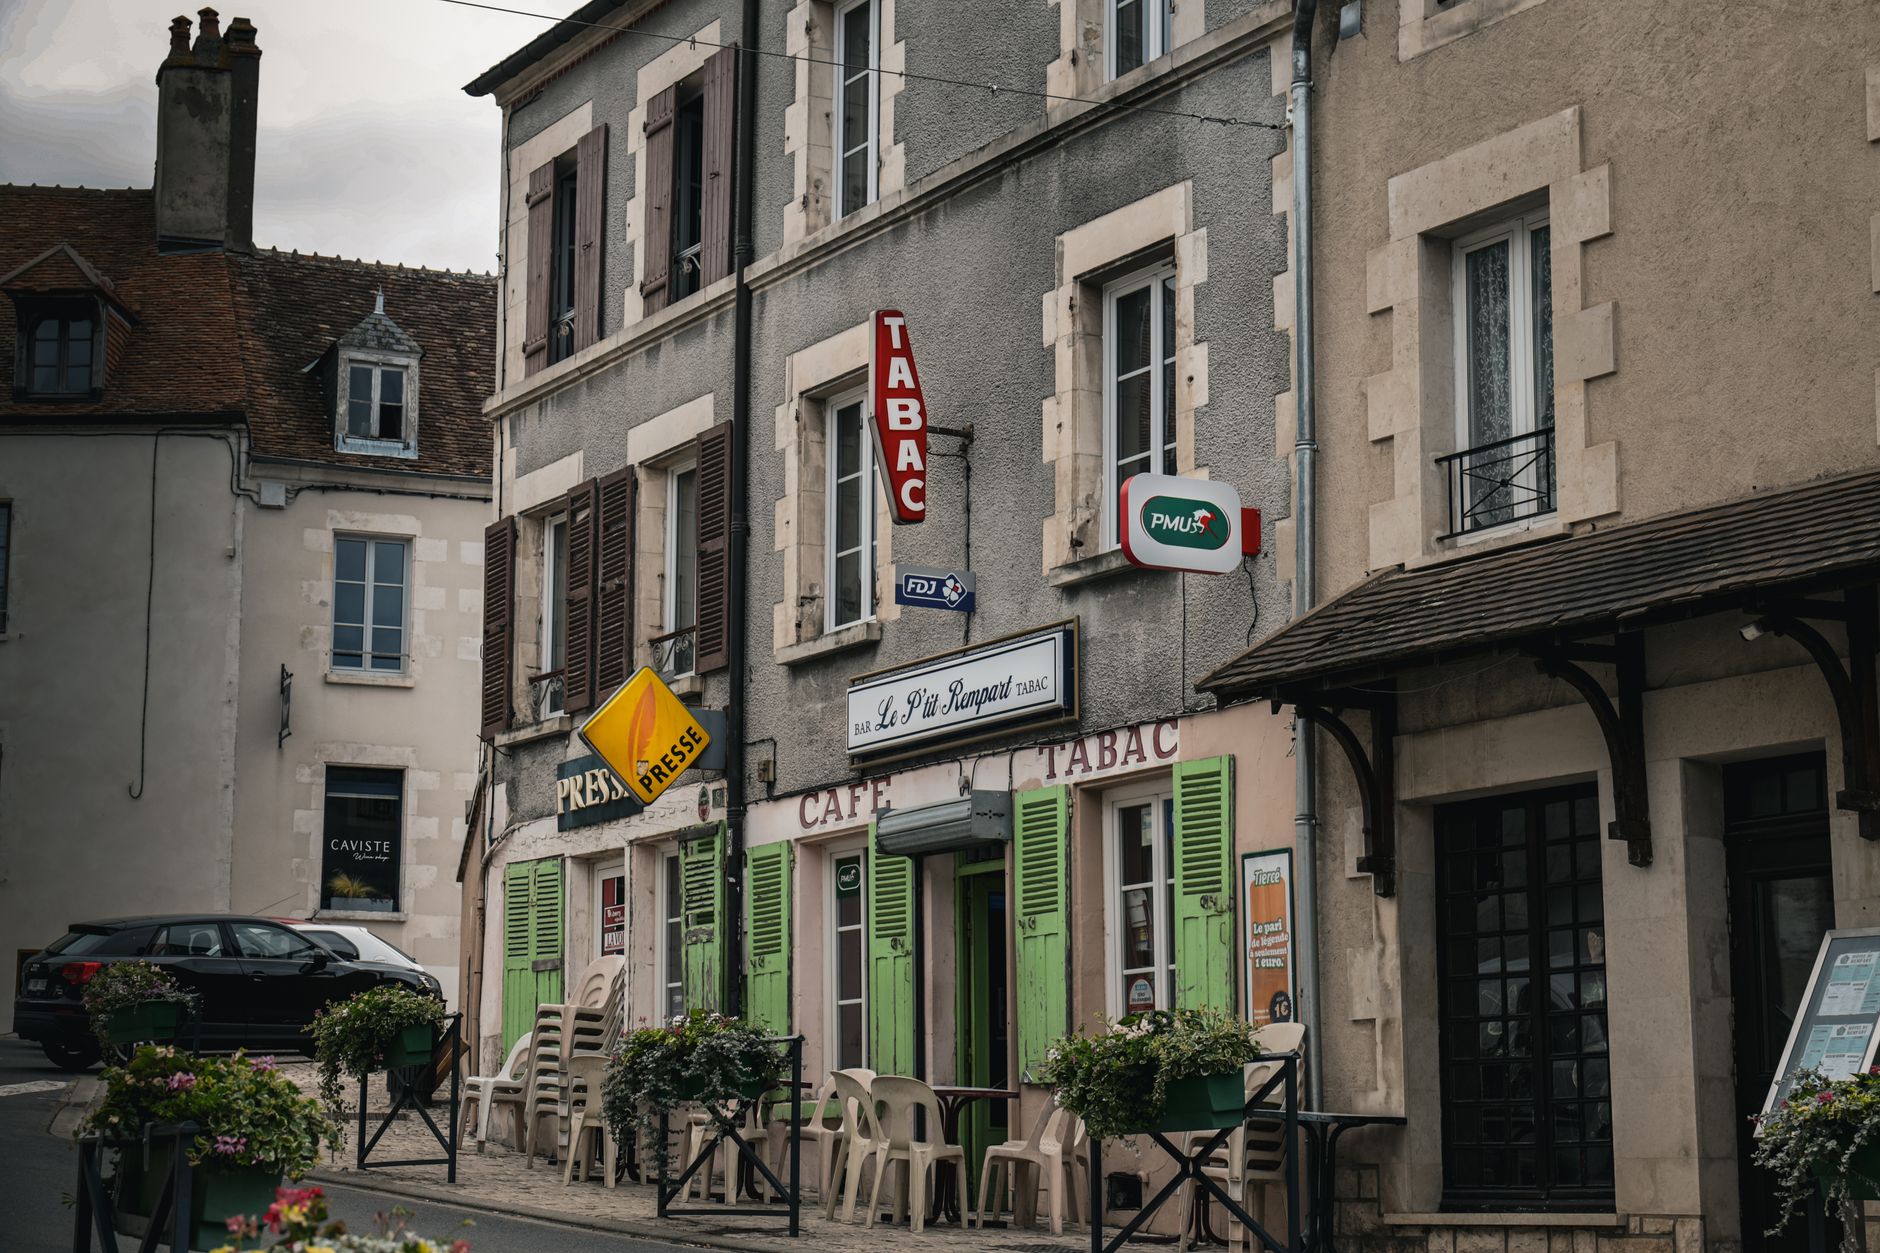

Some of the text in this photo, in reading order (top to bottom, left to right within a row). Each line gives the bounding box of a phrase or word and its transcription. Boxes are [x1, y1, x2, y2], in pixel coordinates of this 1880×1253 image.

[884, 317, 925, 511] TABAC
[1151, 512, 1192, 532] PMU
[907, 579, 937, 595] FDJ
[854, 675, 1048, 736] BAR Le P'tit Rempart TABAC
[1038, 720, 1178, 779] TABAC
[638, 725, 703, 794] PRESSE
[556, 768, 631, 815] PRESS
[800, 776, 891, 829] CAFE
[331, 839, 390, 852] CAVISTE
[1254, 867, 1281, 886] Tiercé
[1253, 919, 1282, 935] Le pari
[1251, 933, 1289, 947] de légende
[1255, 958, 1260, 967] 1
[1275, 1001, 1289, 1018] 1€
